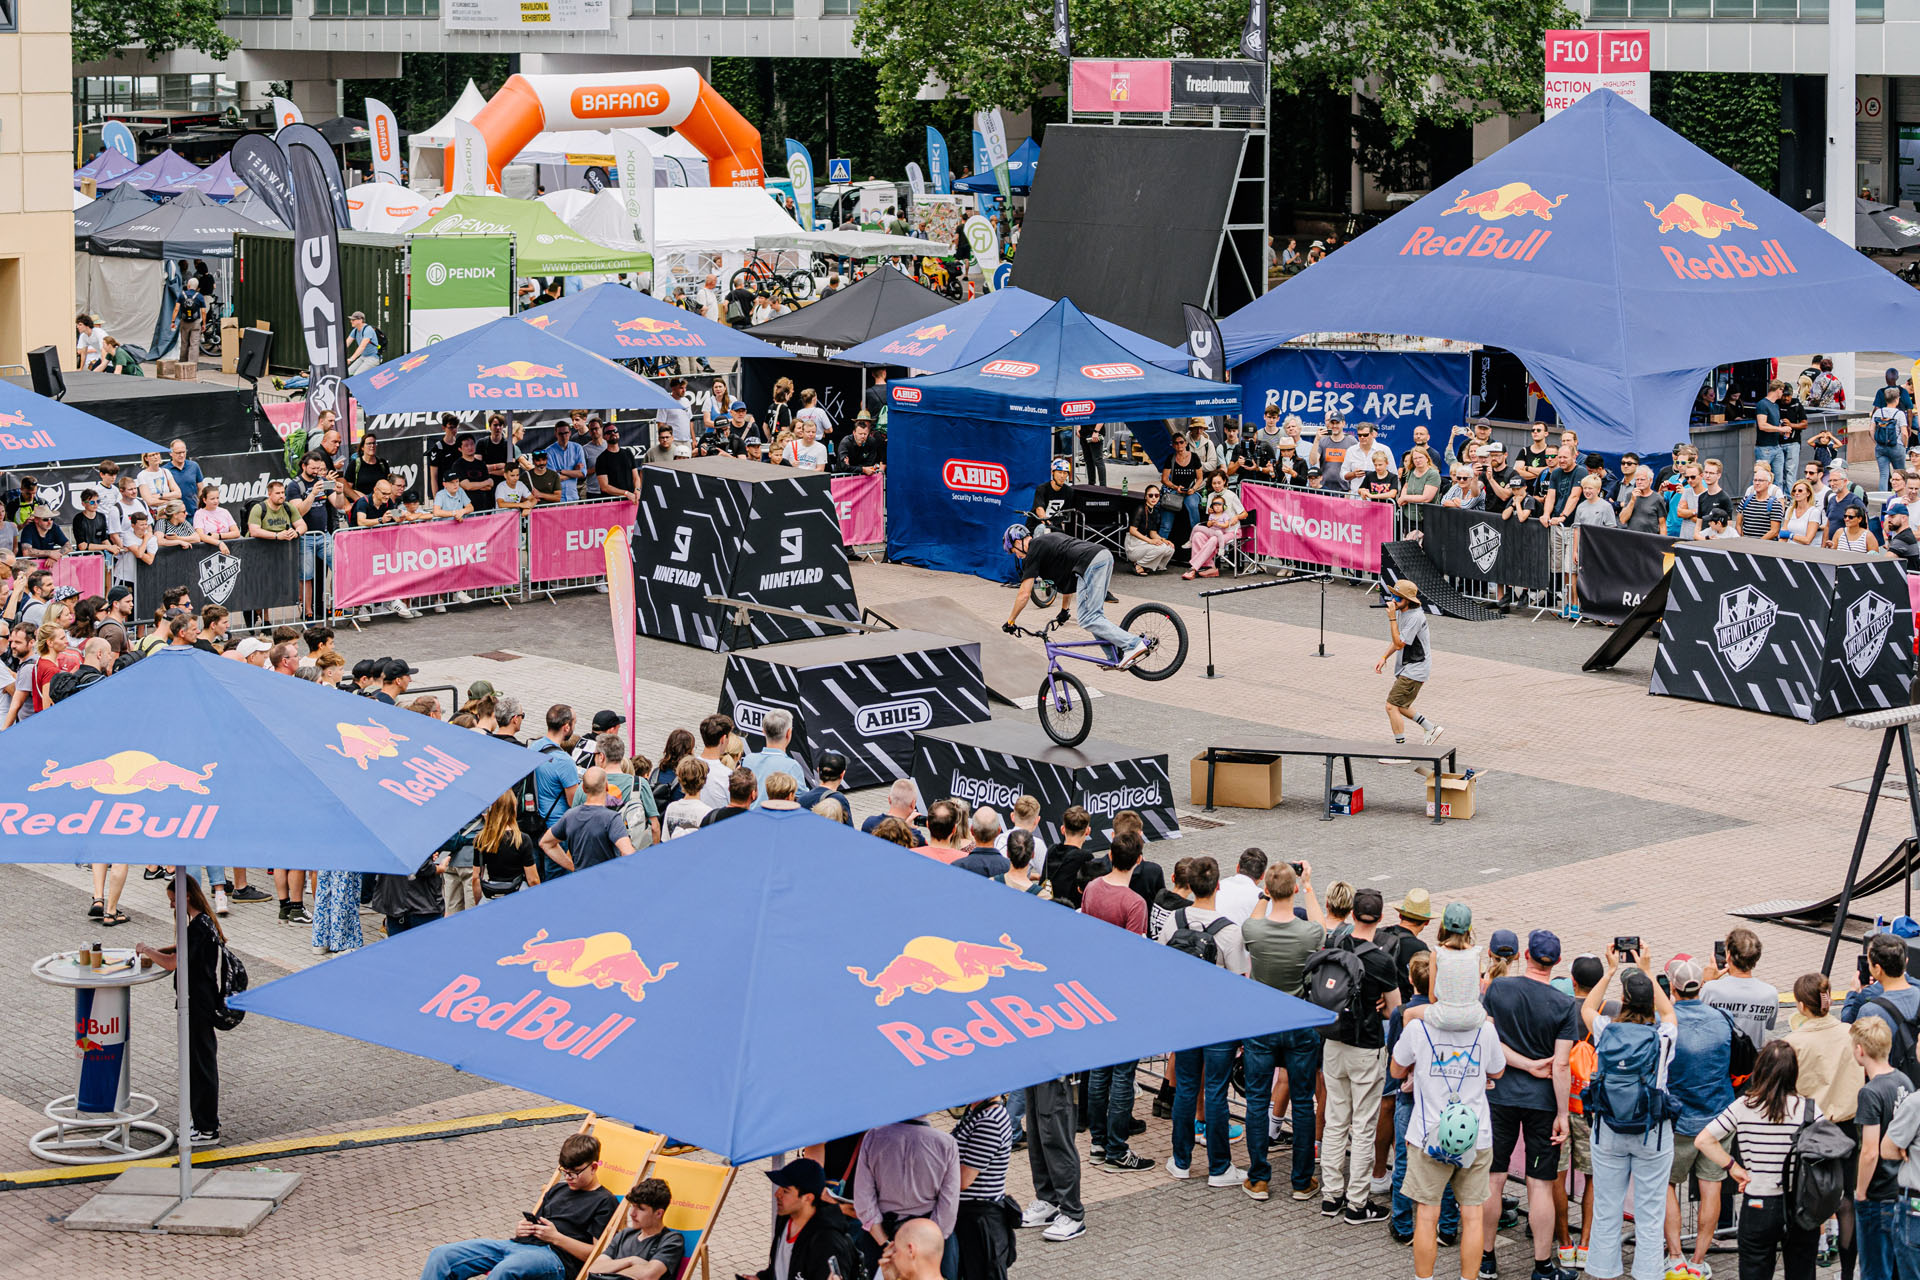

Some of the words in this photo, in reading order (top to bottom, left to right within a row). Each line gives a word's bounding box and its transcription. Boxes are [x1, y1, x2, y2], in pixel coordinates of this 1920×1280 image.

[521, 14, 550, 22] EXHIBITORS
[1553, 40, 1589, 62] F10
[1610, 40, 1642, 62] F10
[1186, 74, 1250, 94] freedombmx
[1545, 81, 1591, 93] ACTION
[582, 91, 659, 112] BAFANG
[378, 120, 388, 157] BAFANG
[731, 167, 759, 179] E-BIKE
[1400, 226, 1481, 257] Red
[1469, 226, 1553, 262] Bull
[542, 258, 631, 273] www.pendix.com
[1659, 245, 1729, 280] Red
[1720, 239, 1798, 278] Bull
[449, 267, 496, 279] PENDIX
[616, 334, 663, 347] Red
[660, 334, 707, 347] Bull
[989, 362, 1032, 374] ABUS
[1091, 365, 1137, 377] ABUS
[468, 383, 523, 399] Red
[527, 383, 579, 398] Bull
[895, 390, 918, 400] ABUS
[1334, 381, 1384, 391] Eurobike.com
[1009, 404, 1048, 414] www.abus.com
[1064, 403, 1091, 413] ABUS
[1195, 397, 1238, 406] www.abus.com
[1265, 389, 1355, 415] RIDERS
[1363, 391, 1433, 420] AREA
[0, 430, 56, 450] Bull
[952, 466, 1002, 488] ABUS
[952, 493, 971, 503] Security
[972, 495, 982, 503] Tech
[983, 496, 1002, 506] Germany
[1270, 511, 1362, 545] EUROBIKE
[372, 542, 488, 575] EUROBIKE
[652, 565, 701, 588] NINEYARD
[759, 567, 824, 591] NINEYARD
[1720, 624, 1748, 646] INFINITY
[1749, 612, 1773, 633] STREET
[1848, 628, 1870, 657] INFINITY
[1870, 613, 1891, 639] STREET
[865, 706, 921, 728] ABUS
[410, 744, 471, 783] Bull
[378, 761, 448, 806] Red
[0, 801, 103, 836] Red
[101, 804, 219, 839] Bull
[87, 1016, 119, 1035] Bull
[419, 974, 542, 1031] Red
[506, 996, 636, 1060] Bull
[877, 1000, 1001, 1066] Red
[998, 980, 1118, 1037] Bull
